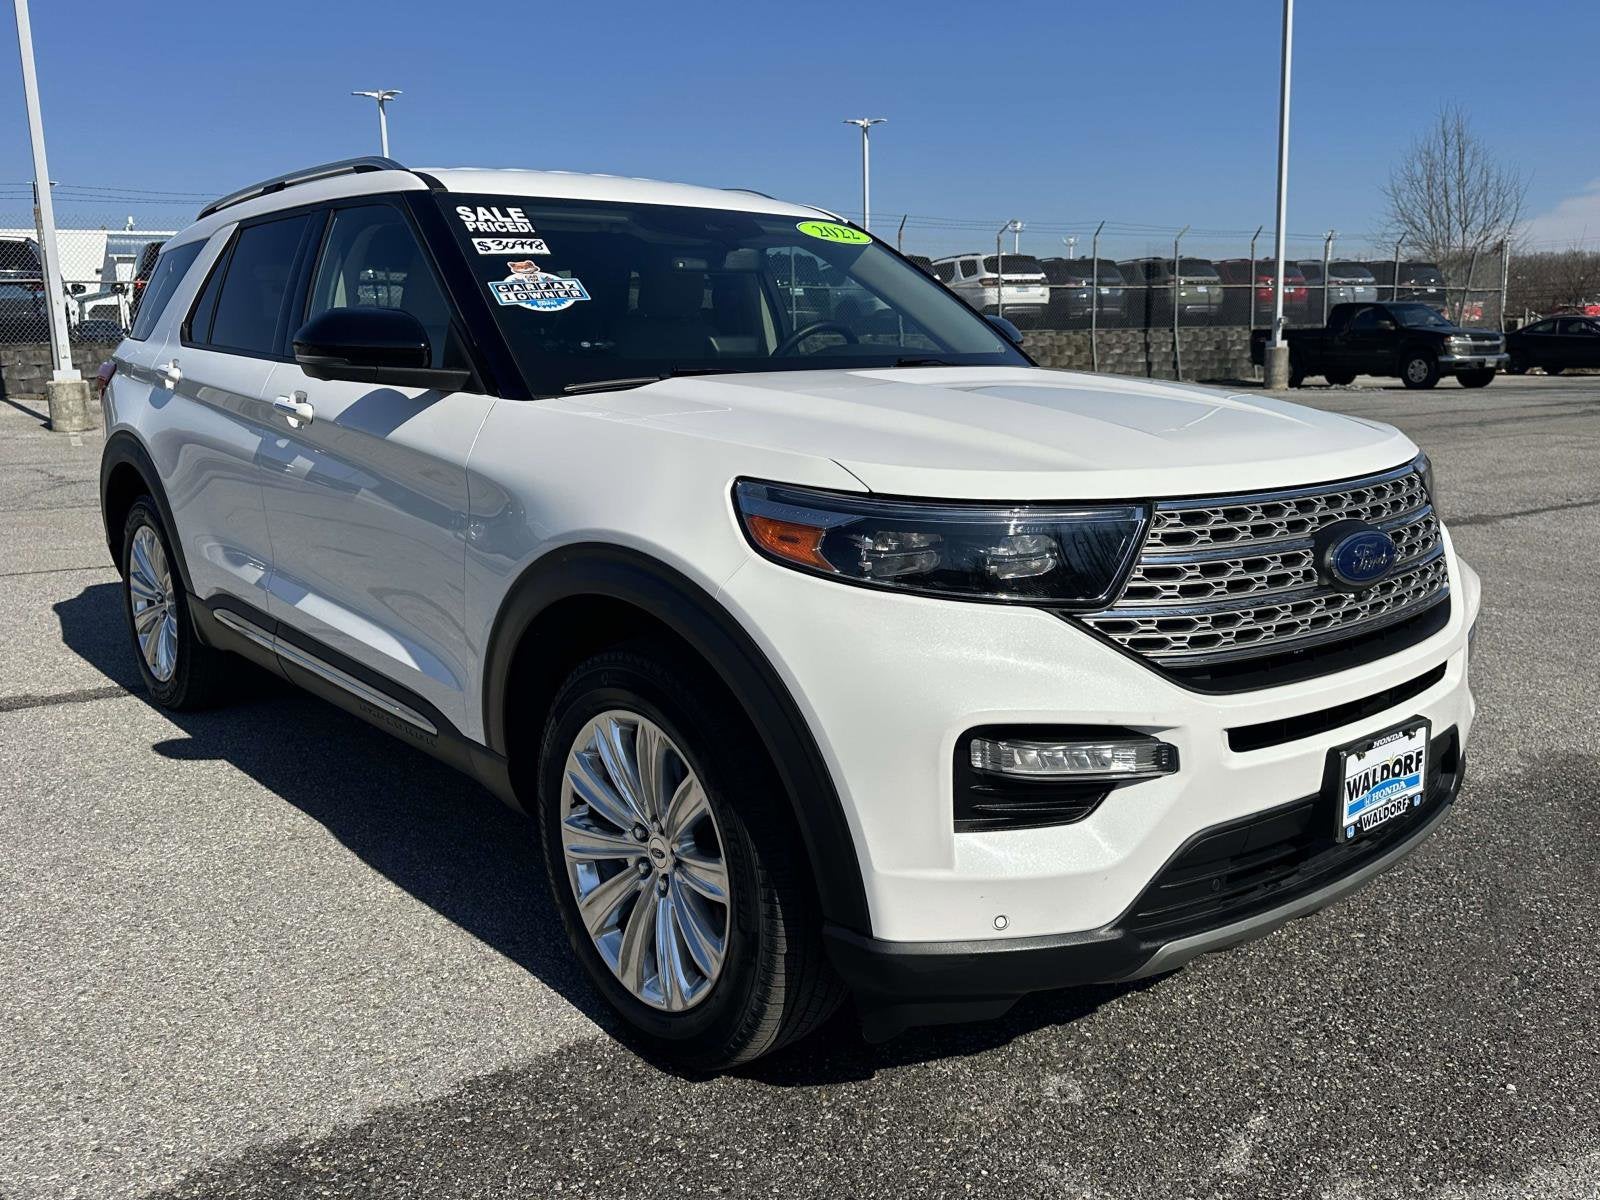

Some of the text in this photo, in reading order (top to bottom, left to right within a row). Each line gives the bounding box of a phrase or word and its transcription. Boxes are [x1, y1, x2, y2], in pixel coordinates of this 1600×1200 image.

[455, 206, 530, 222] SALE
[465, 221, 536, 233] PRICED!
[811, 225, 860, 240] 2022
[497, 282, 577, 293] CARFAX
[516, 290, 582, 300] OWNER
[1372, 731, 1404, 749] HONDA
[1346, 750, 1424, 802] WALDORF
[1371, 780, 1407, 802] HONDA
[1362, 798, 1408, 830] WALDORF
